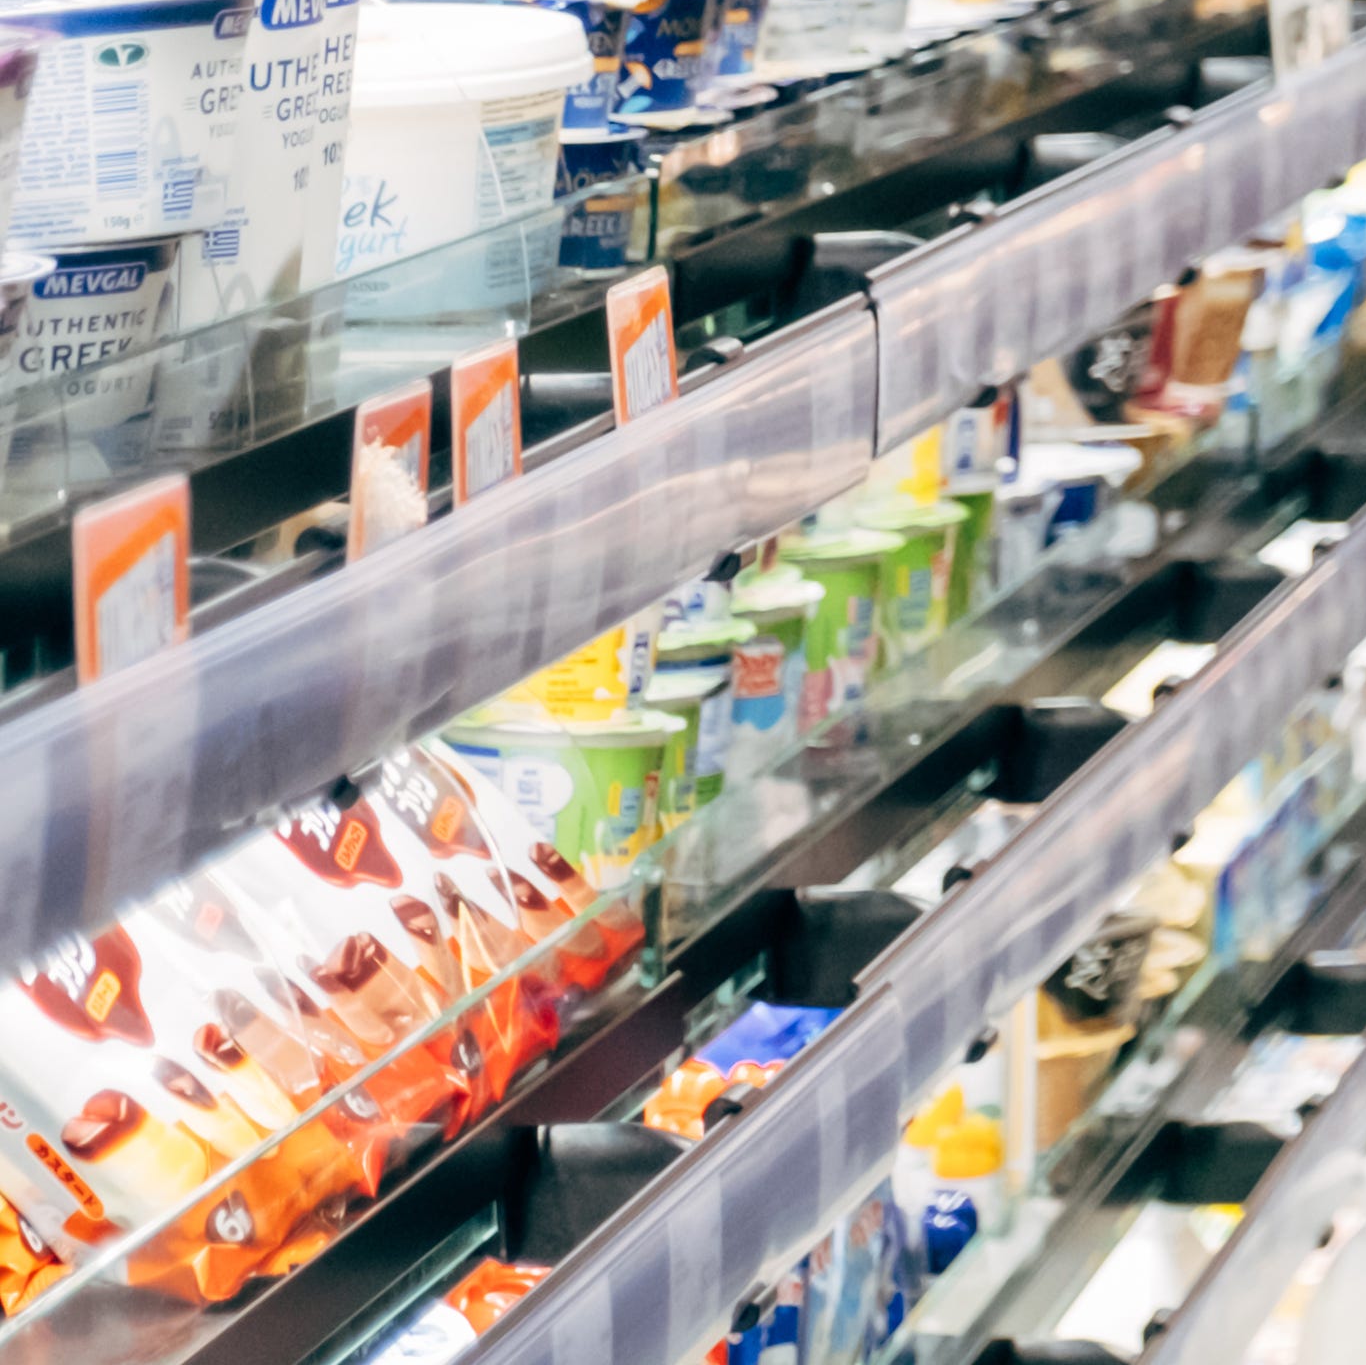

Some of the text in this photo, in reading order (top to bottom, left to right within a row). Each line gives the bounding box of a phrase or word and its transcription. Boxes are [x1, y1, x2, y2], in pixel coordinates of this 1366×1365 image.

[43, 268, 140, 296] MEVGAL
[26, 307, 148, 338] UTHENTIC
[65, 375, 134, 397] OGURT
